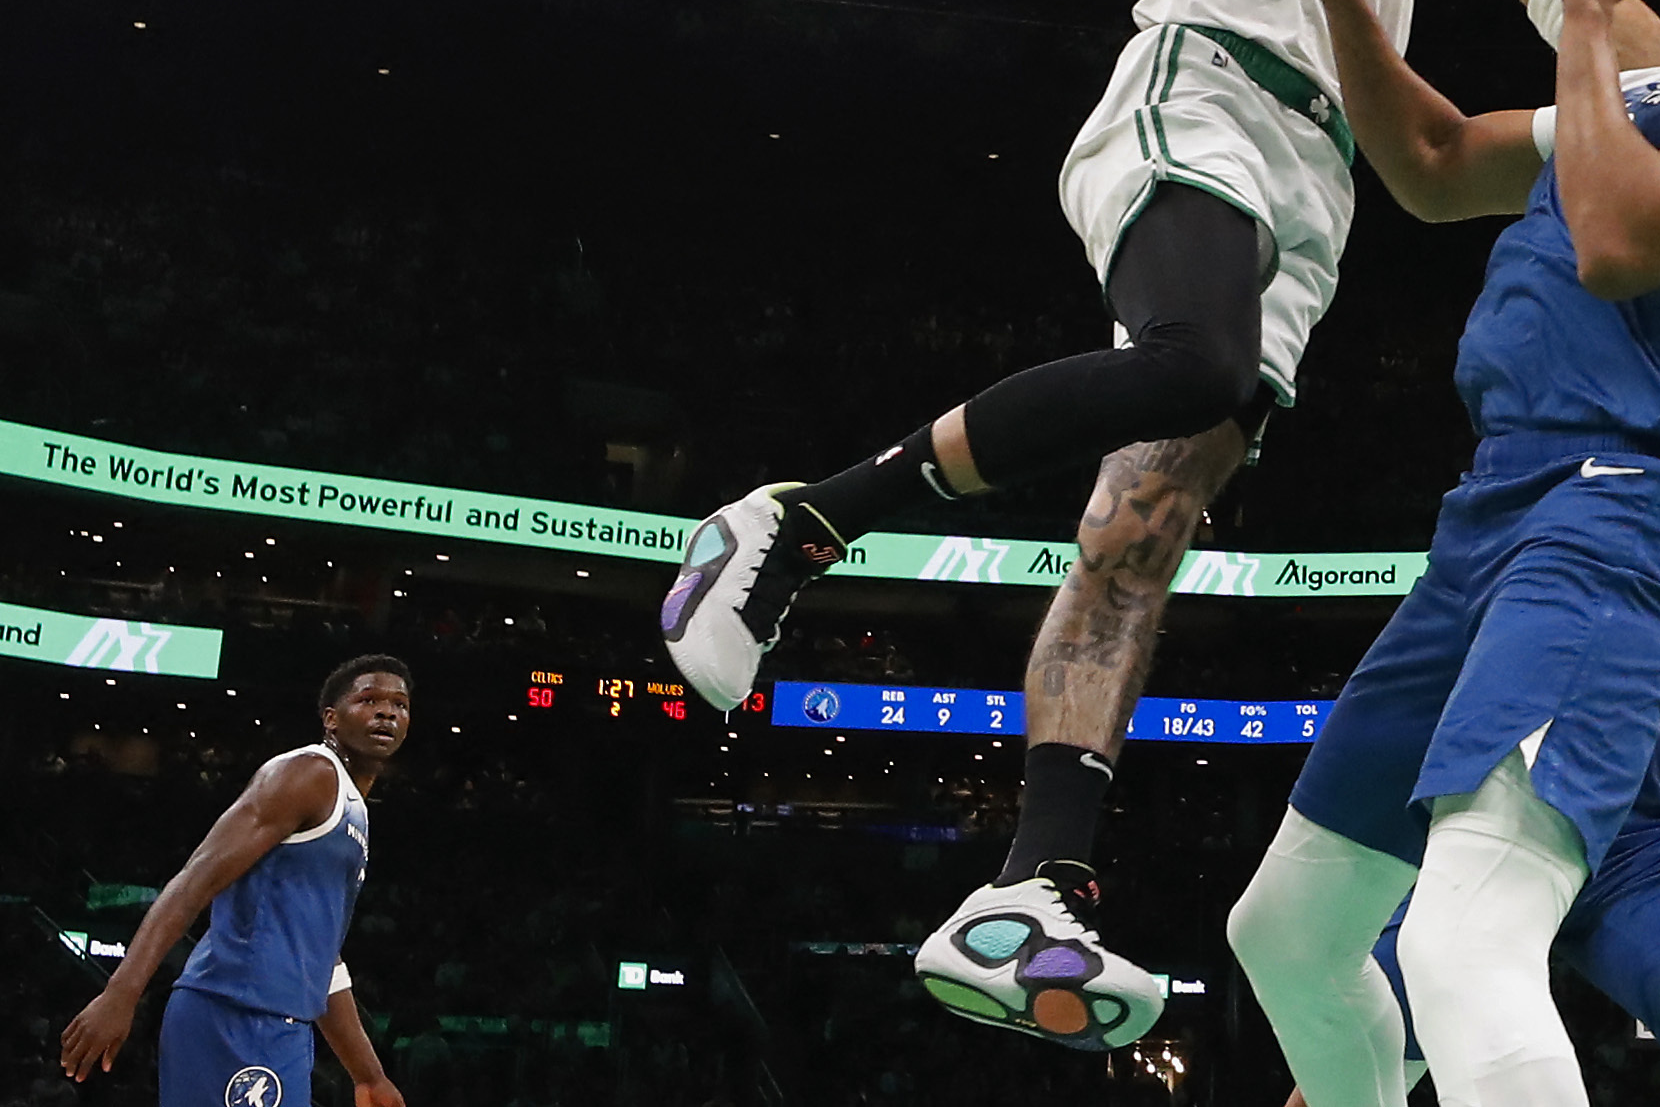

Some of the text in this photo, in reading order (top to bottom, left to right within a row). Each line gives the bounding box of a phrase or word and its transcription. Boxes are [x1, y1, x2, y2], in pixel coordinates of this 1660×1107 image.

[43, 442, 690, 553] The World's Most Powerful and Sustainabl
[1276, 559, 1396, 588] Algorand
[531, 671, 563, 686] CELTICS
[598, 678, 634, 698] 1:27
[527, 688, 553, 708] 50
[882, 690, 1318, 716] REB AST STL FG FG% TOL
[662, 701, 687, 720] 46
[881, 706, 1314, 738] 24 9 2 18/43 42 5
[650, 970, 684, 984] Bank
